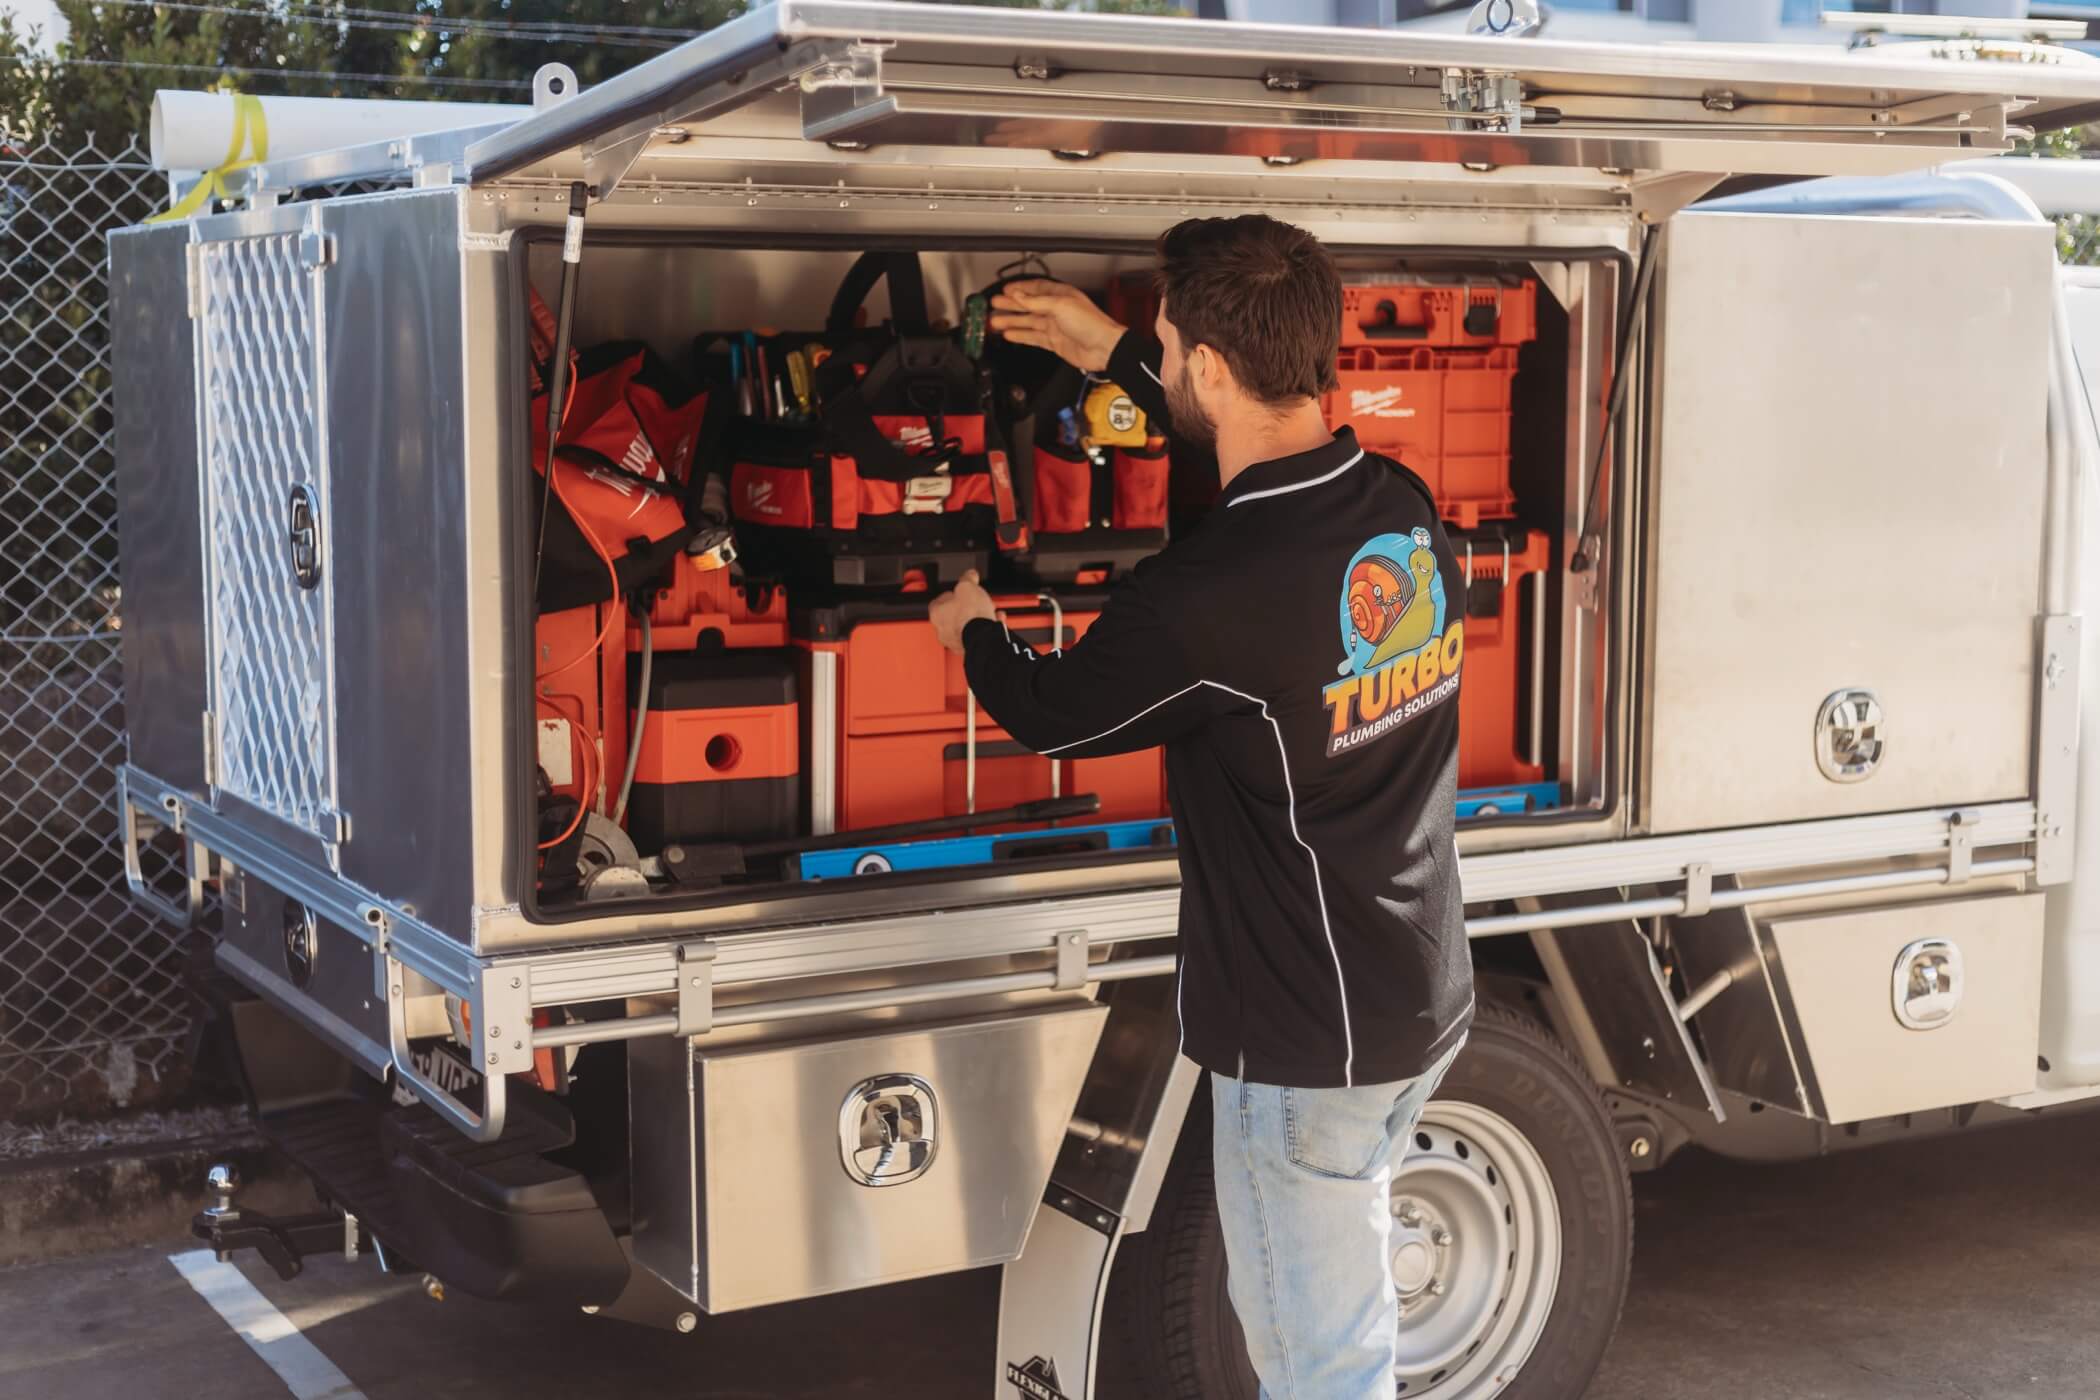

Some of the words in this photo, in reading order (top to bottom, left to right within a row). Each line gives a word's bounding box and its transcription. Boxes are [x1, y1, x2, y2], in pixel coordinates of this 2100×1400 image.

[1324, 620, 1464, 734] TURBO
[1332, 708, 1403, 752] PLUMBING
[1404, 673, 1460, 719] SOLUTIONS
